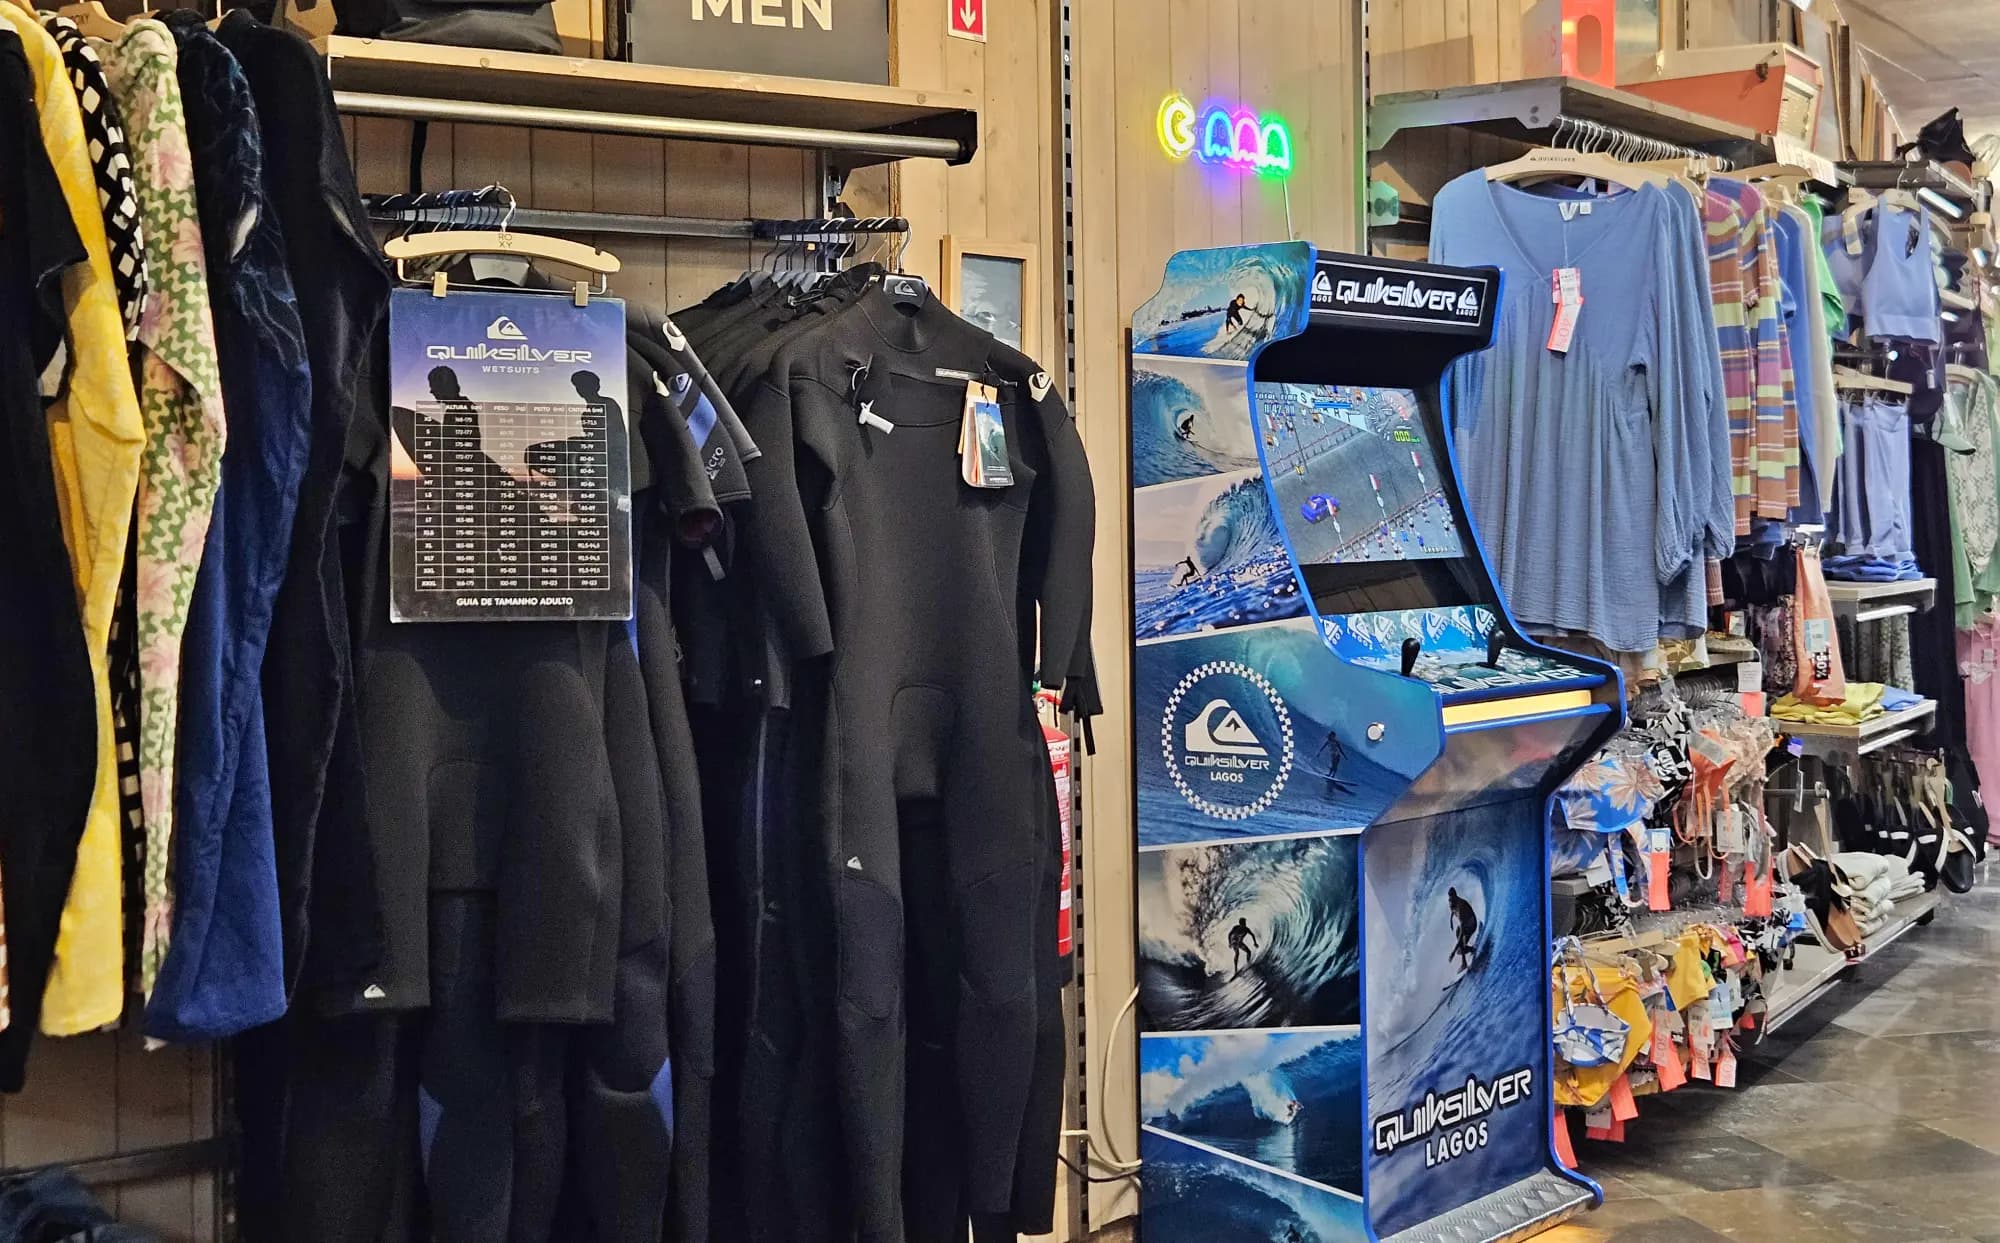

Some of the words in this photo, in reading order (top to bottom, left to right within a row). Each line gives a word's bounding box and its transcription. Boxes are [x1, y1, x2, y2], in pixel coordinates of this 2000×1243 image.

[691, 0, 832, 30] MEN
[1311, 294, 1333, 304] AGOS
[1336, 276, 1457, 312] QUIKSILVER
[1455, 308, 1478, 317] LAGOS
[427, 342, 592, 363] QUIKSILVER
[482, 365, 540, 374] WETSUITS
[456, 597, 479, 606] GUIA
[480, 597, 492, 606] DE
[494, 597, 538, 606] TAMANHO
[539, 597, 574, 606] ADULTO
[1184, 754, 1270, 771] QUIKSILVER
[1210, 771, 1244, 783] LAGOS
[1375, 1067, 1533, 1152] QUIKSILVER
[1425, 1120, 1489, 1167] LAGOS
